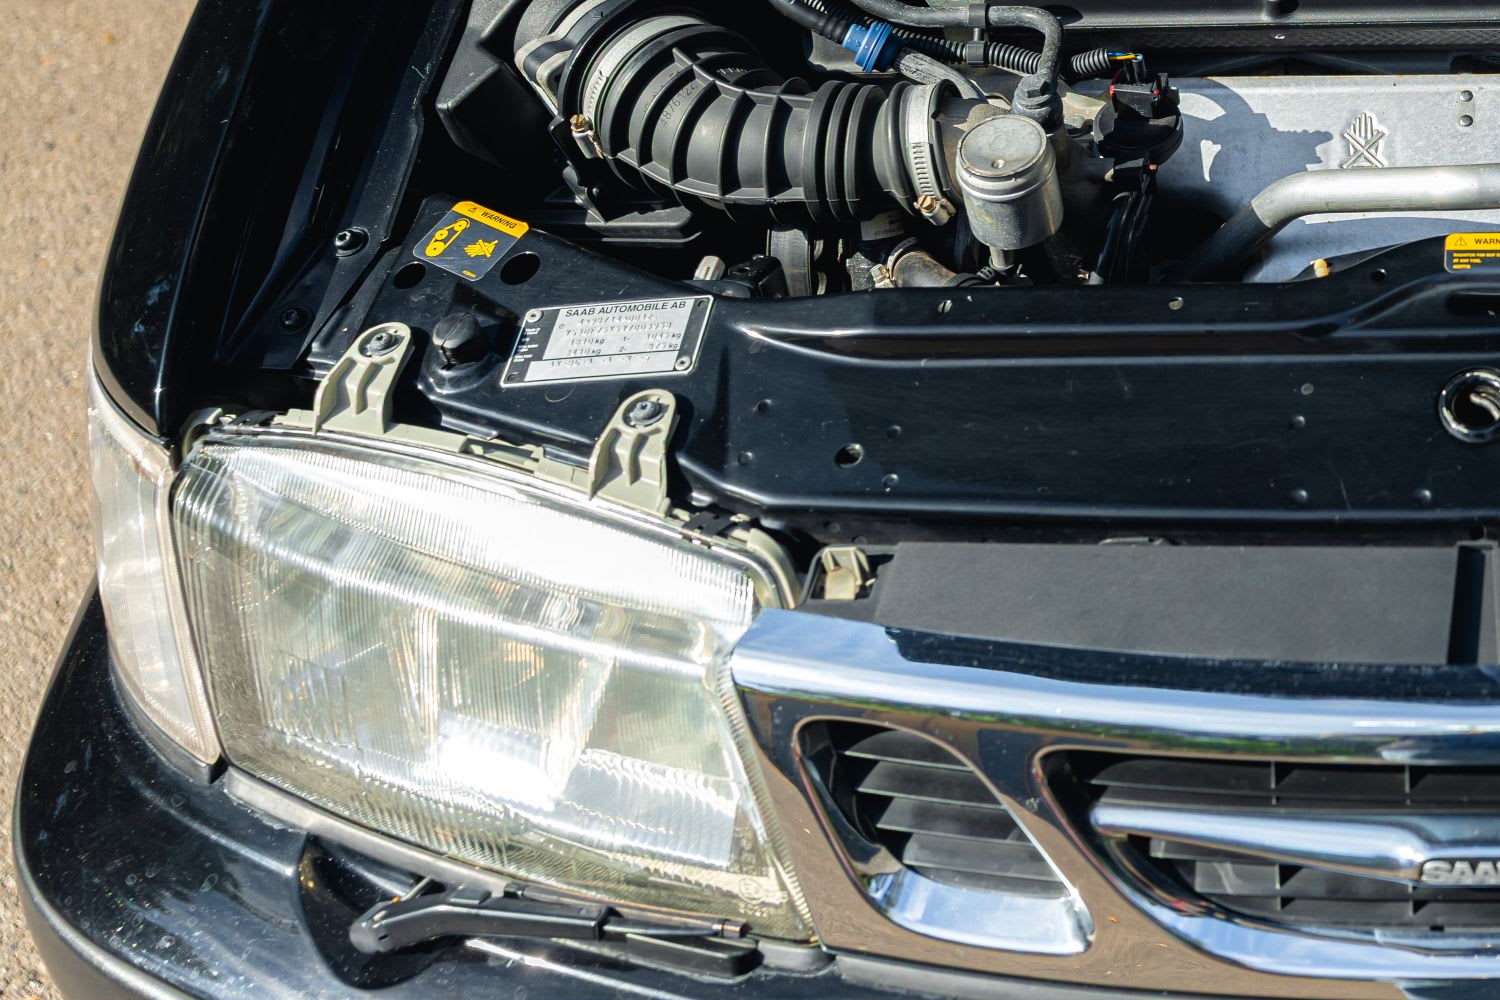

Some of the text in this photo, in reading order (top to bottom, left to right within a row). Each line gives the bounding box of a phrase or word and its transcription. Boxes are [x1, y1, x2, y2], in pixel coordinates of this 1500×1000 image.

[480, 210, 518, 229] WARNING
[564, 300, 687, 317] SAAB AUTOMOBILE AB
